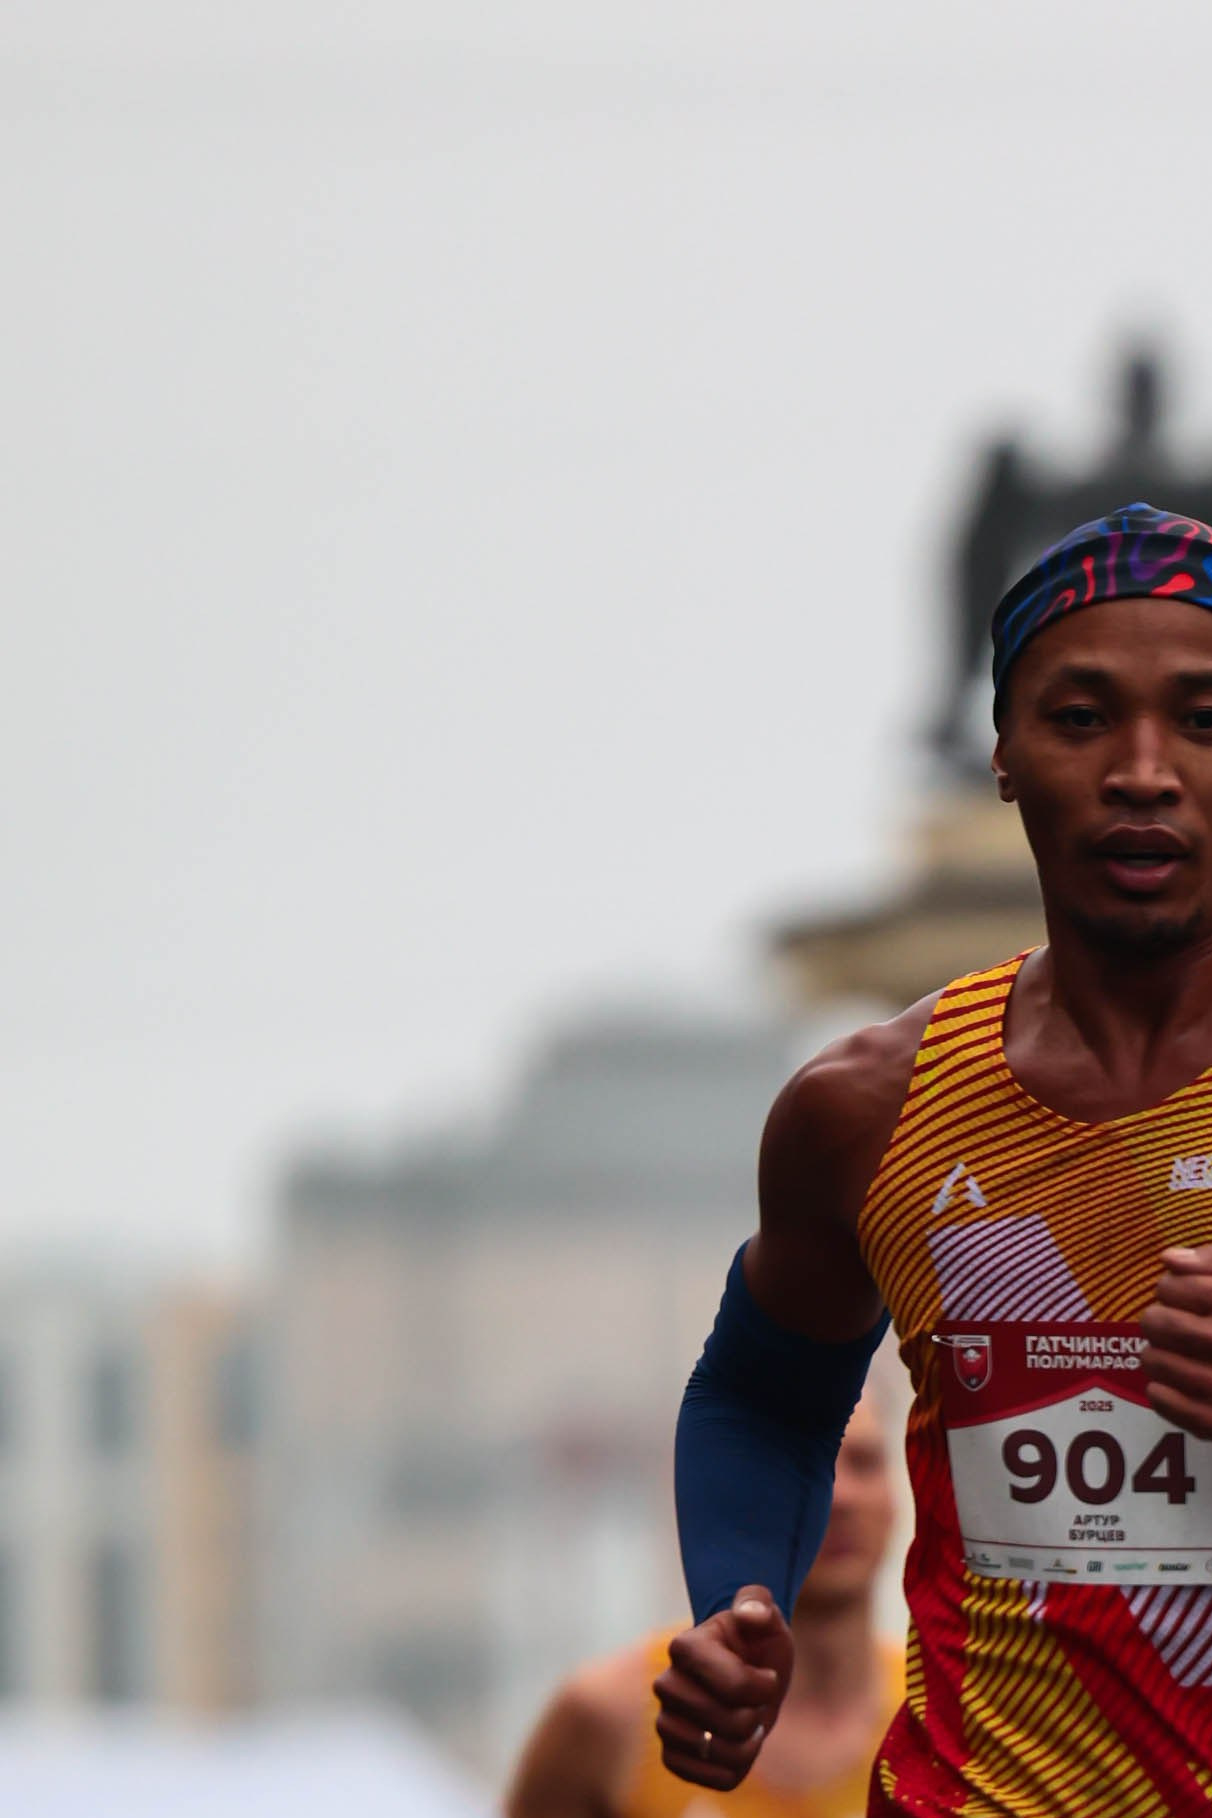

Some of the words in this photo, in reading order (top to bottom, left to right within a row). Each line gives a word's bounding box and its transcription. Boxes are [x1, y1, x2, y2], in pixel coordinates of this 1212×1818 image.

[1026, 1354, 1142, 1370] ПОЛУМАРАФ
[1079, 1400, 1113, 1412] 2025
[1002, 1429, 1196, 1505] 904
[1073, 1514, 1120, 1526] АРТУР
[1069, 1529, 1125, 1542] БУРЦЕВ
